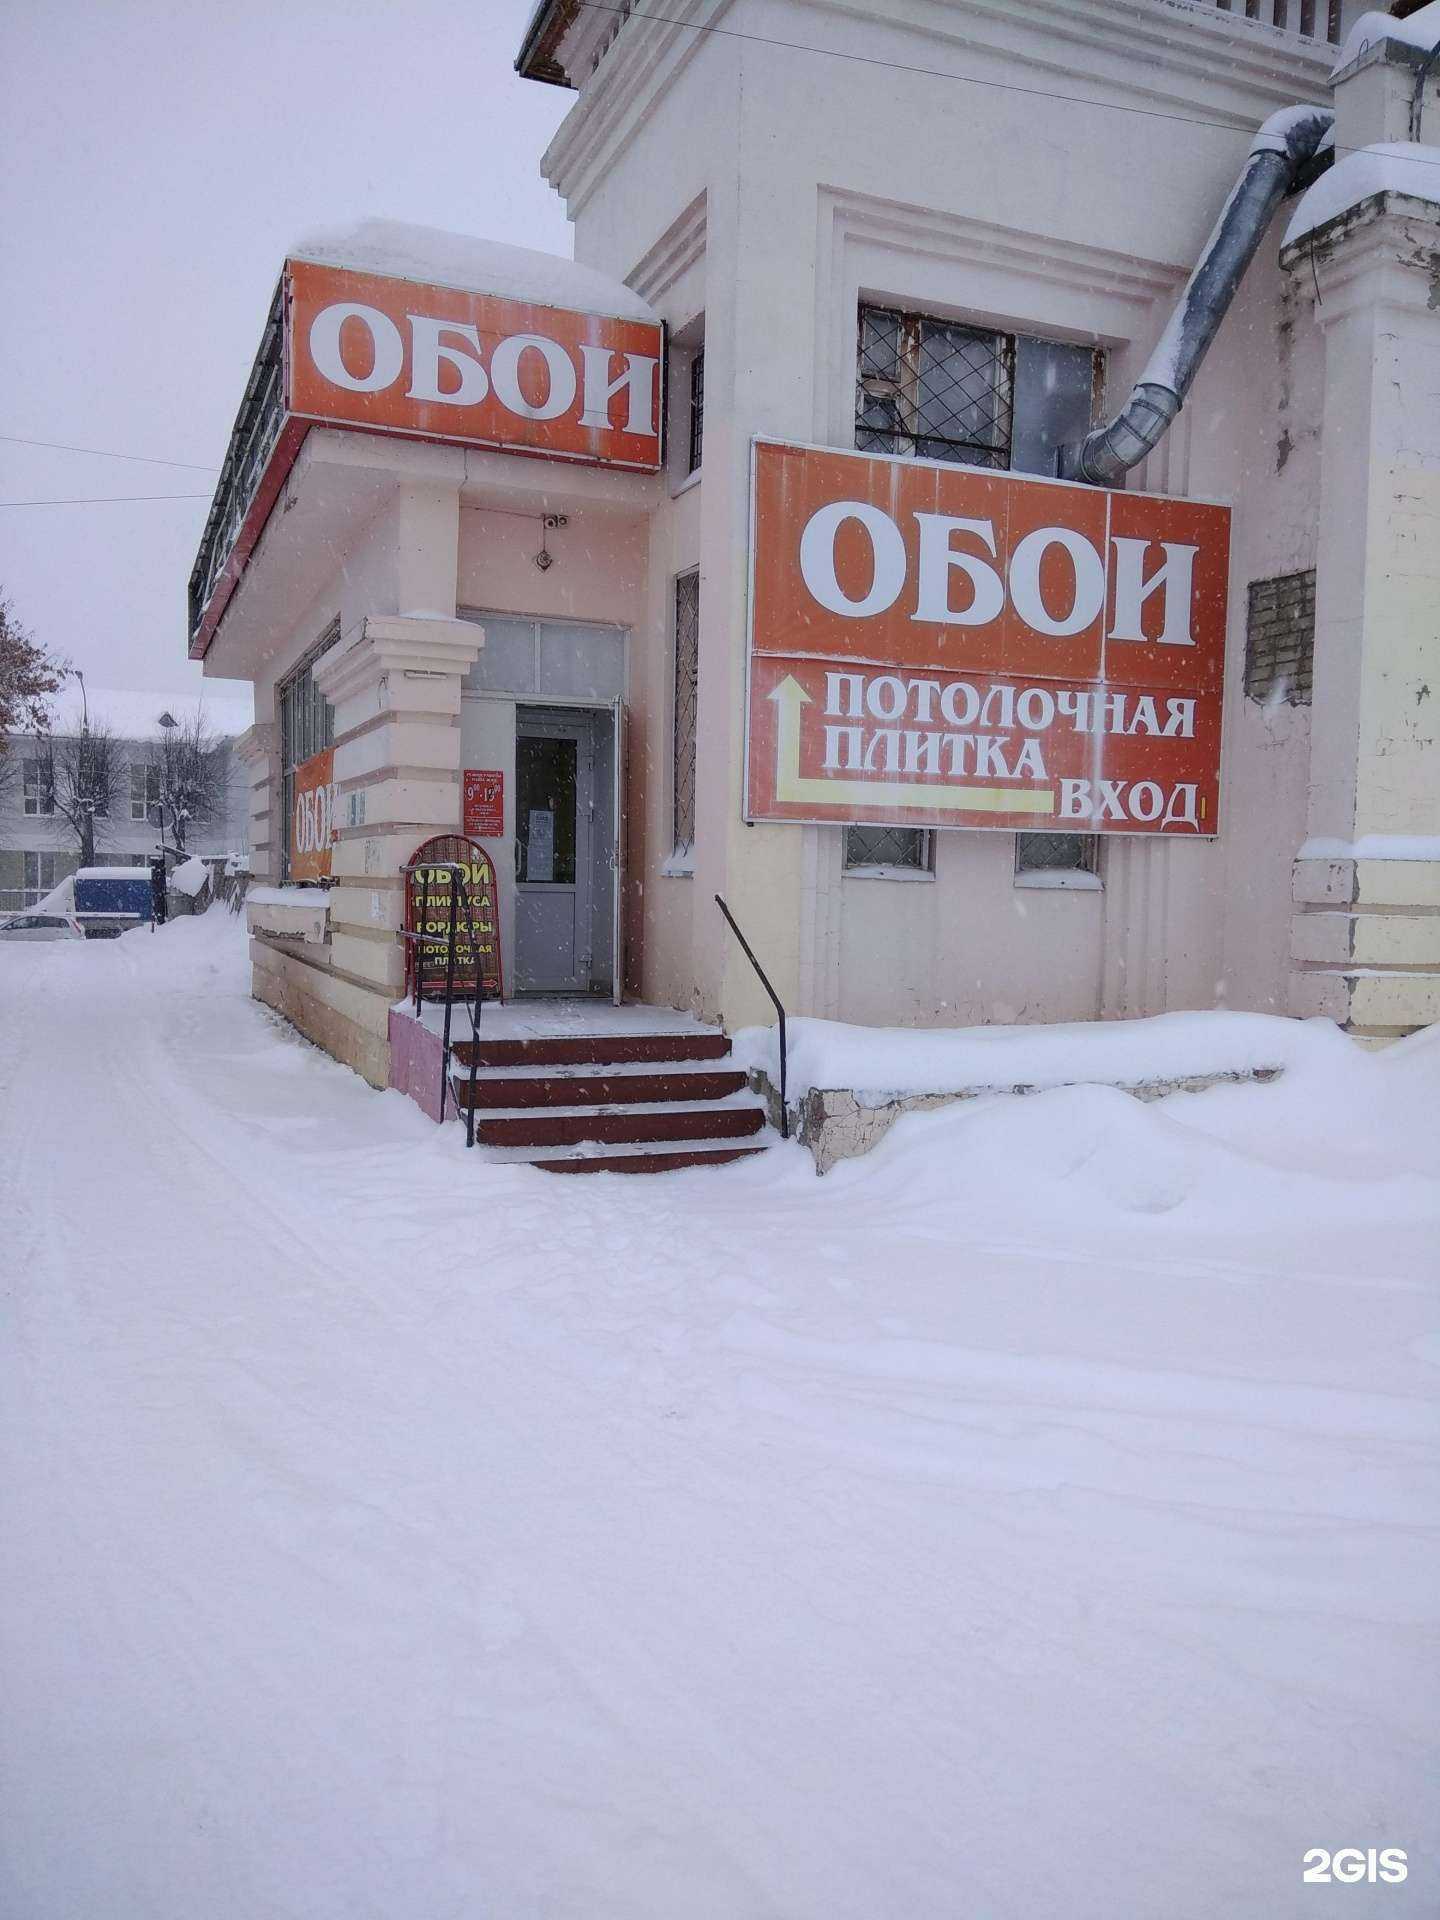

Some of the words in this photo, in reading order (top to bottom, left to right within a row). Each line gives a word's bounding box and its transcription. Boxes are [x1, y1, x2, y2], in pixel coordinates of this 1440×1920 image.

[309, 302, 659, 437] ОБОИ
[799, 500, 1200, 646] ОБОИ
[824, 671, 1197, 738] ПОТОЛОЧНАЯ
[822, 725, 1049, 779] ПЛИТКА
[1058, 778, 1200, 832] ВХОД
[418, 944, 492, 954] ПОТООЧАЯ
[434, 956, 475, 966] ПЛТКА
